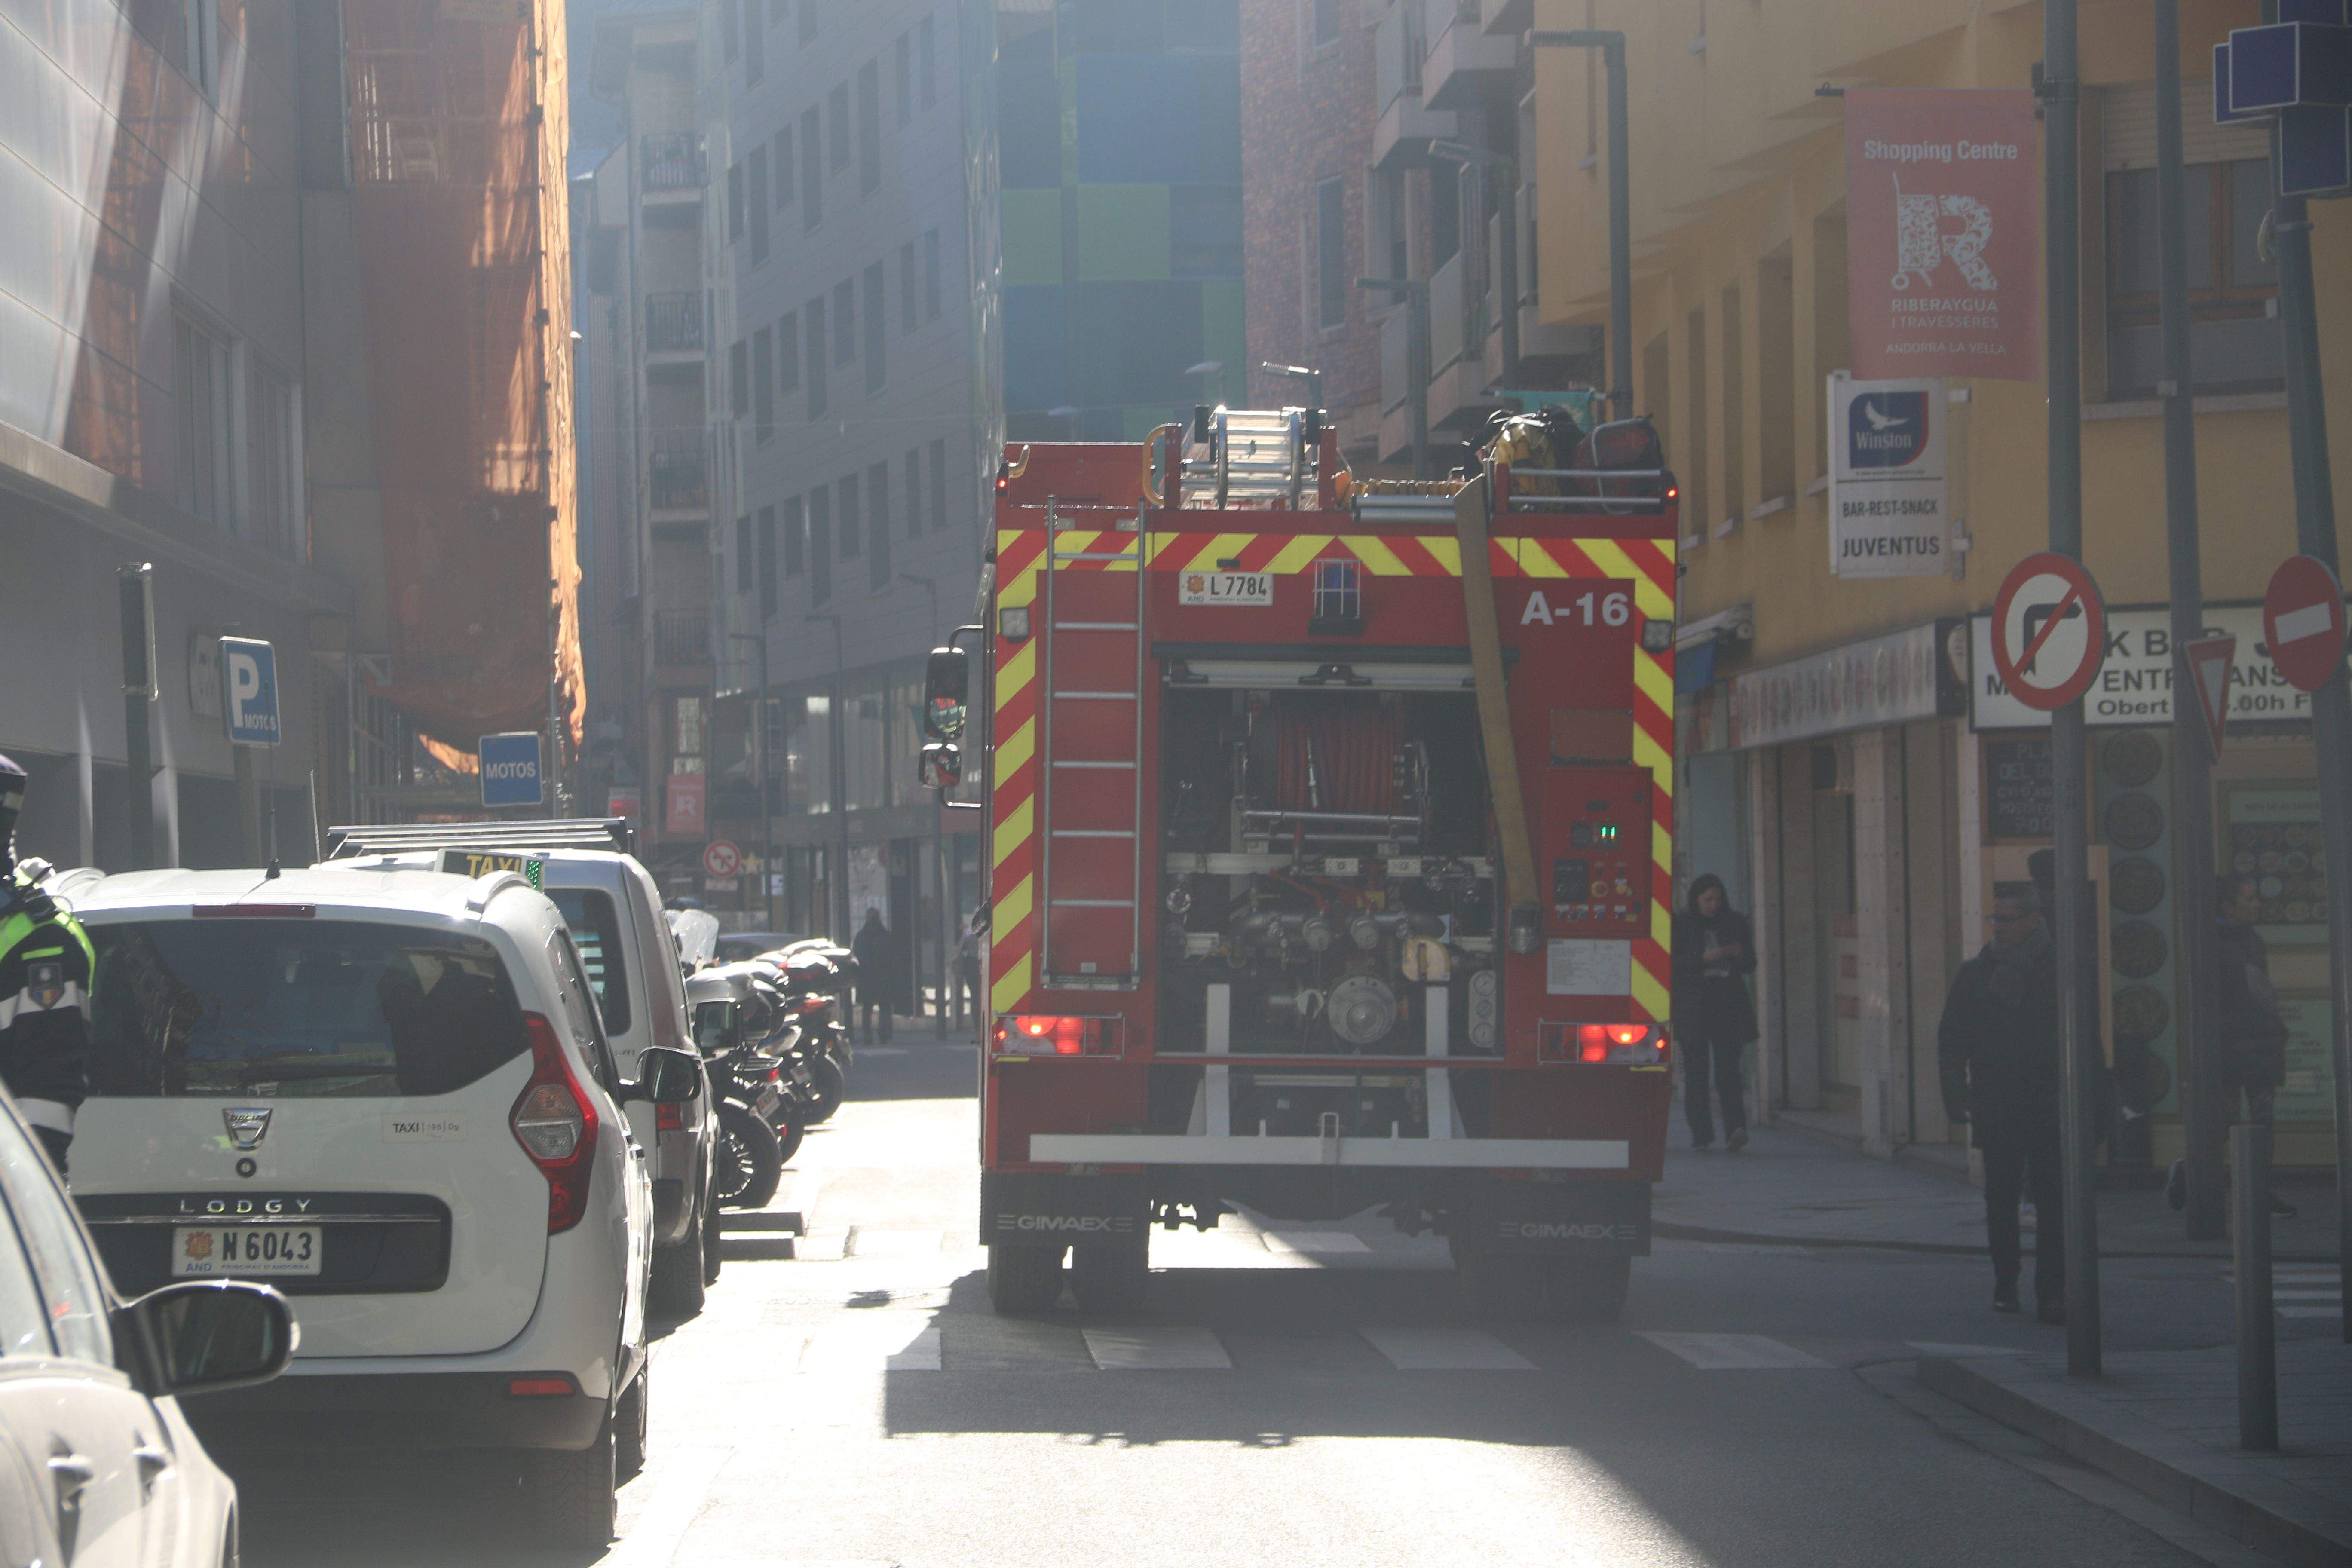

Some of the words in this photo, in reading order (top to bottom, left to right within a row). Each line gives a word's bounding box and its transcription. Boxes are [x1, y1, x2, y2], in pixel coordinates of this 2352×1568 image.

[1865, 140, 1951, 163] Shopping
[1957, 140, 2017, 159] Centre
[1891, 298, 1998, 312] RIBERAYGUA
[1892, 316, 1896, 328] I
[1899, 316, 1998, 329] TRAVESSERES
[1886, 342, 1946, 354] ANDORRA
[1949, 343, 1965, 353] LA
[1969, 343, 2006, 354] VELLA
[1856, 432, 1912, 450] Winston
[1843, 499, 1938, 517] BAR-REST-SNACK
[1843, 536, 1939, 558] JUVENTUS
[1211, 576, 1219, 595] L
[1226, 576, 1267, 596] 7784
[1520, 591, 1629, 626] A-16
[229, 652, 259, 727] P
[2098, 698, 2168, 715] Obert
[2229, 694, 2285, 711] .00h
[486, 761, 536, 780] MOTOS
[466, 854, 520, 879] TAXI
[392, 1121, 419, 1133] TAXI
[180, 1199, 311, 1213] LODGY
[1017, 1215, 1112, 1231] GIMAEX
[1520, 1223, 1614, 1239] GIMAEX
[222, 1232, 237, 1261] N
[245, 1232, 312, 1261] 6043
[185, 1263, 212, 1272] AND
